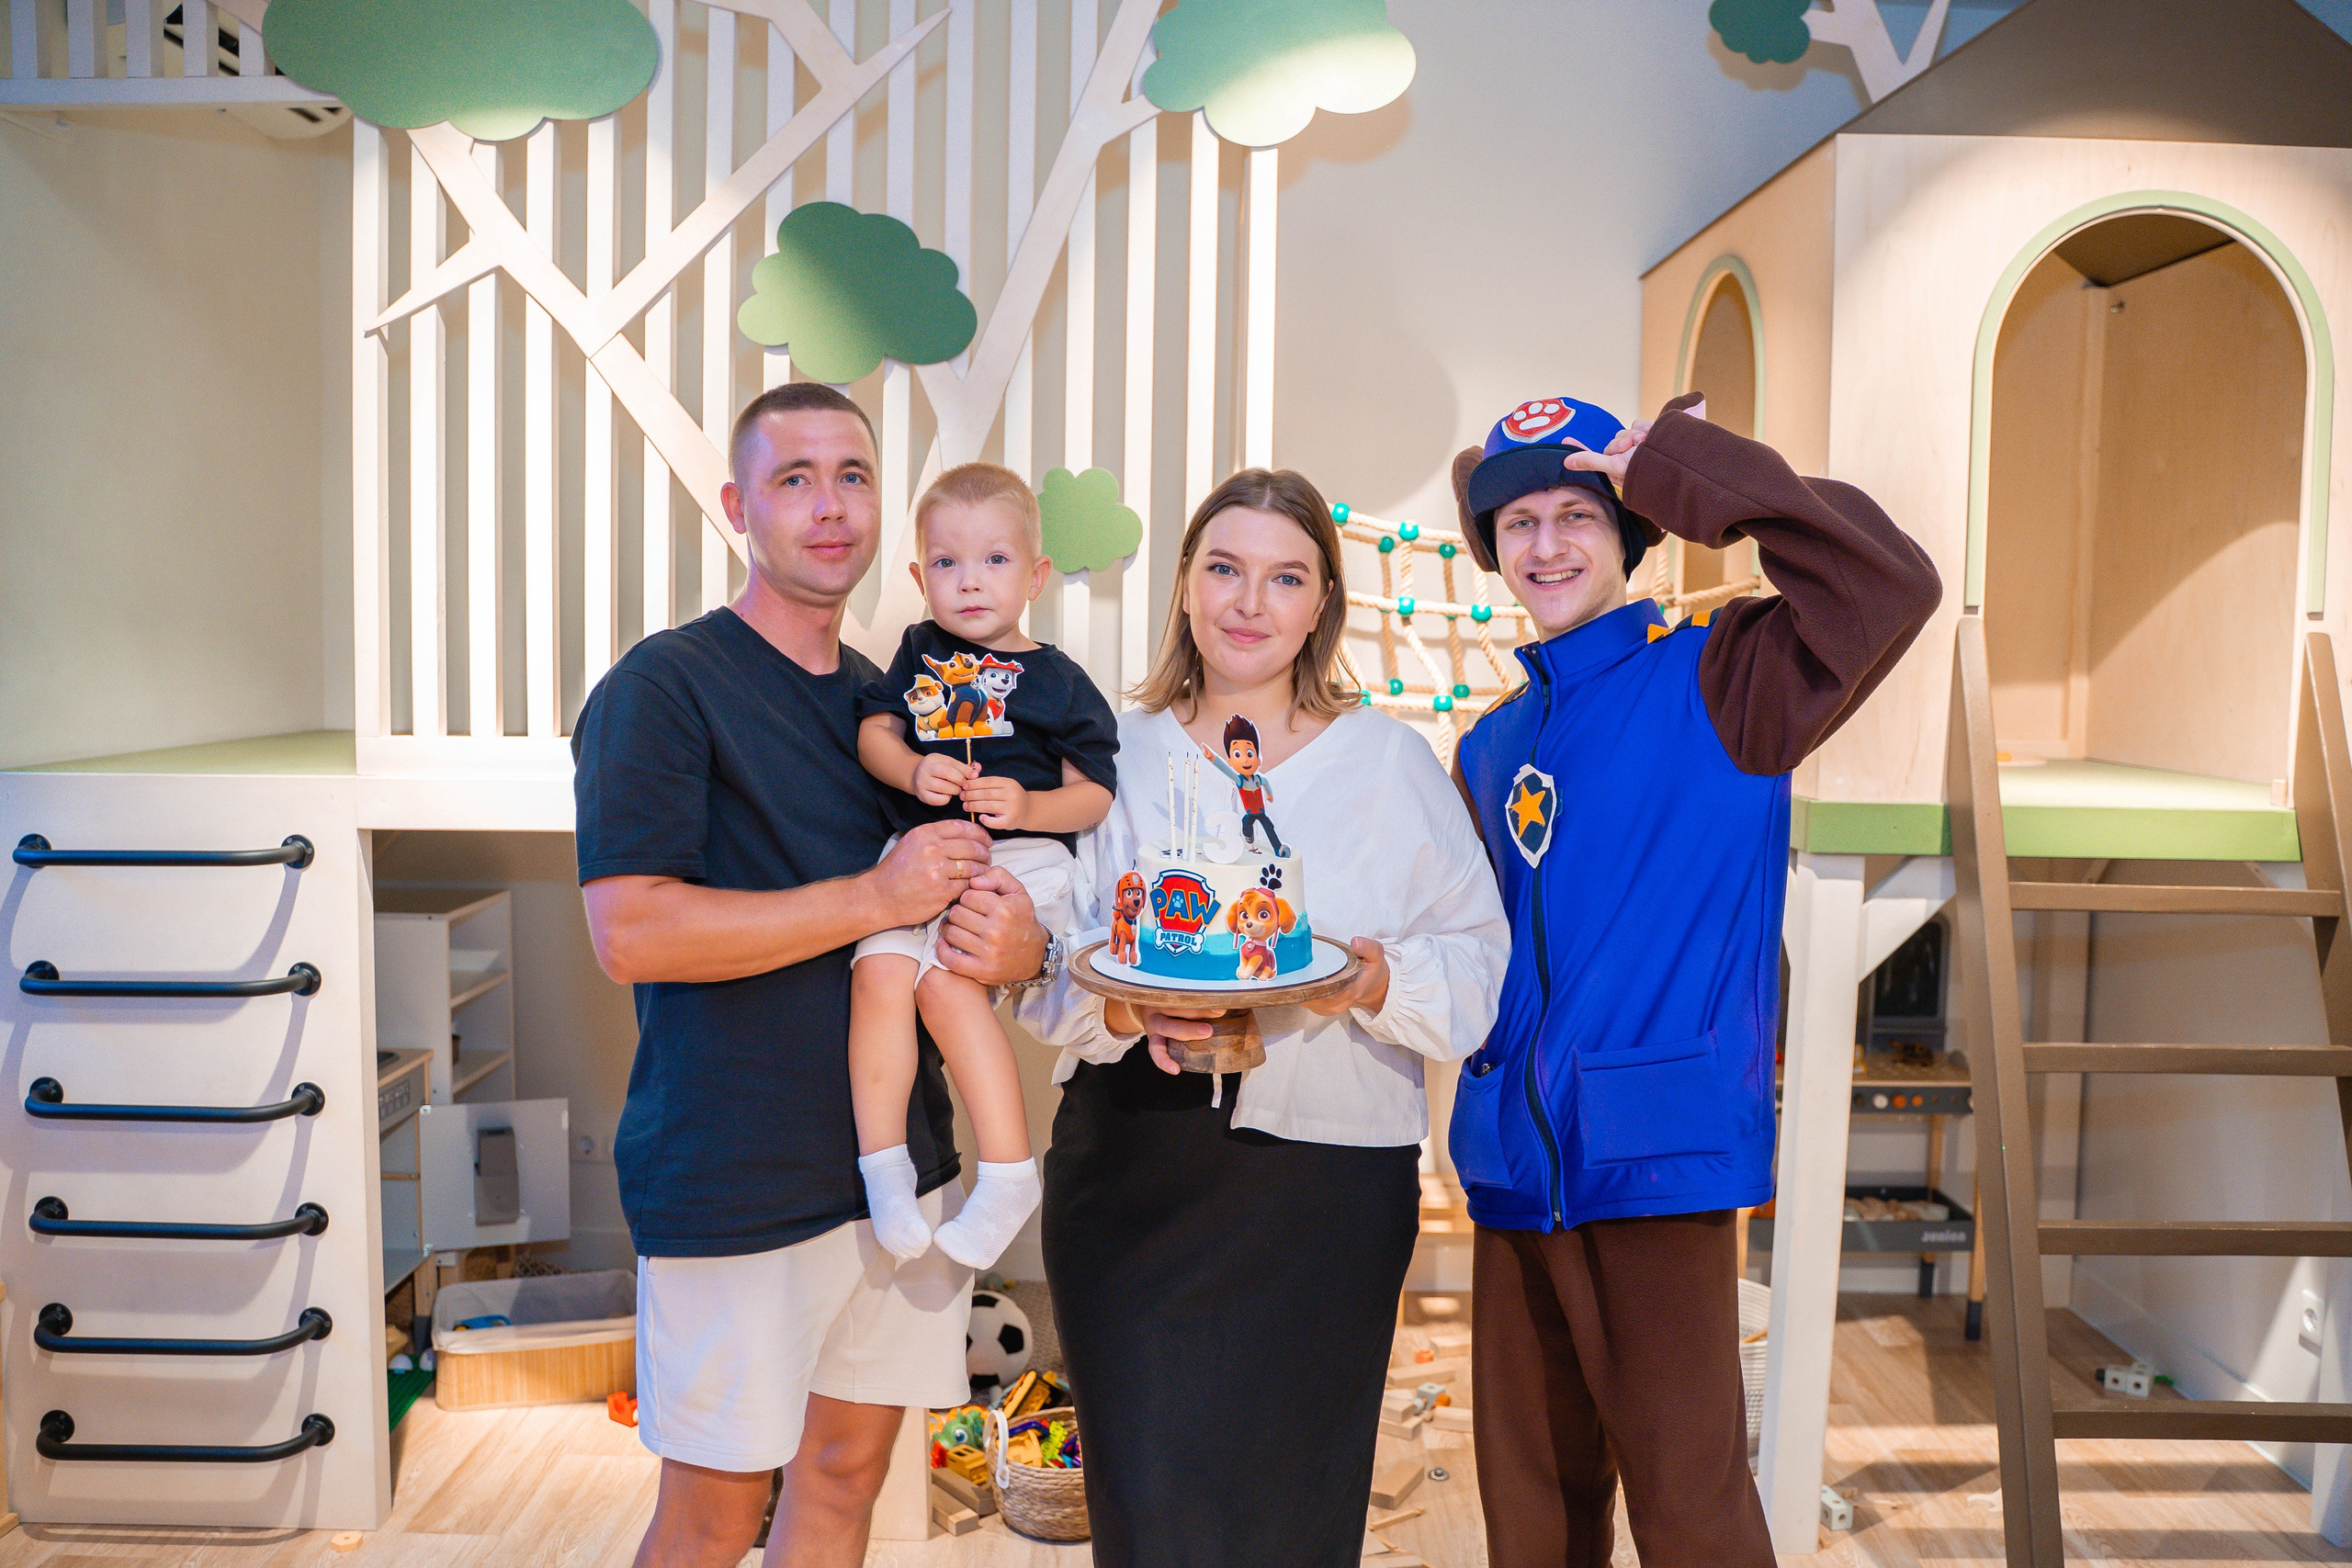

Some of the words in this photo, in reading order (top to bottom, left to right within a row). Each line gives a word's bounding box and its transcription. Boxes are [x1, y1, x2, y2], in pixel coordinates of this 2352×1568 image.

[1203, 810, 1244, 863] 3
[1149, 886, 1222, 927] PAW
[1159, 931, 1197, 947] PATROL
